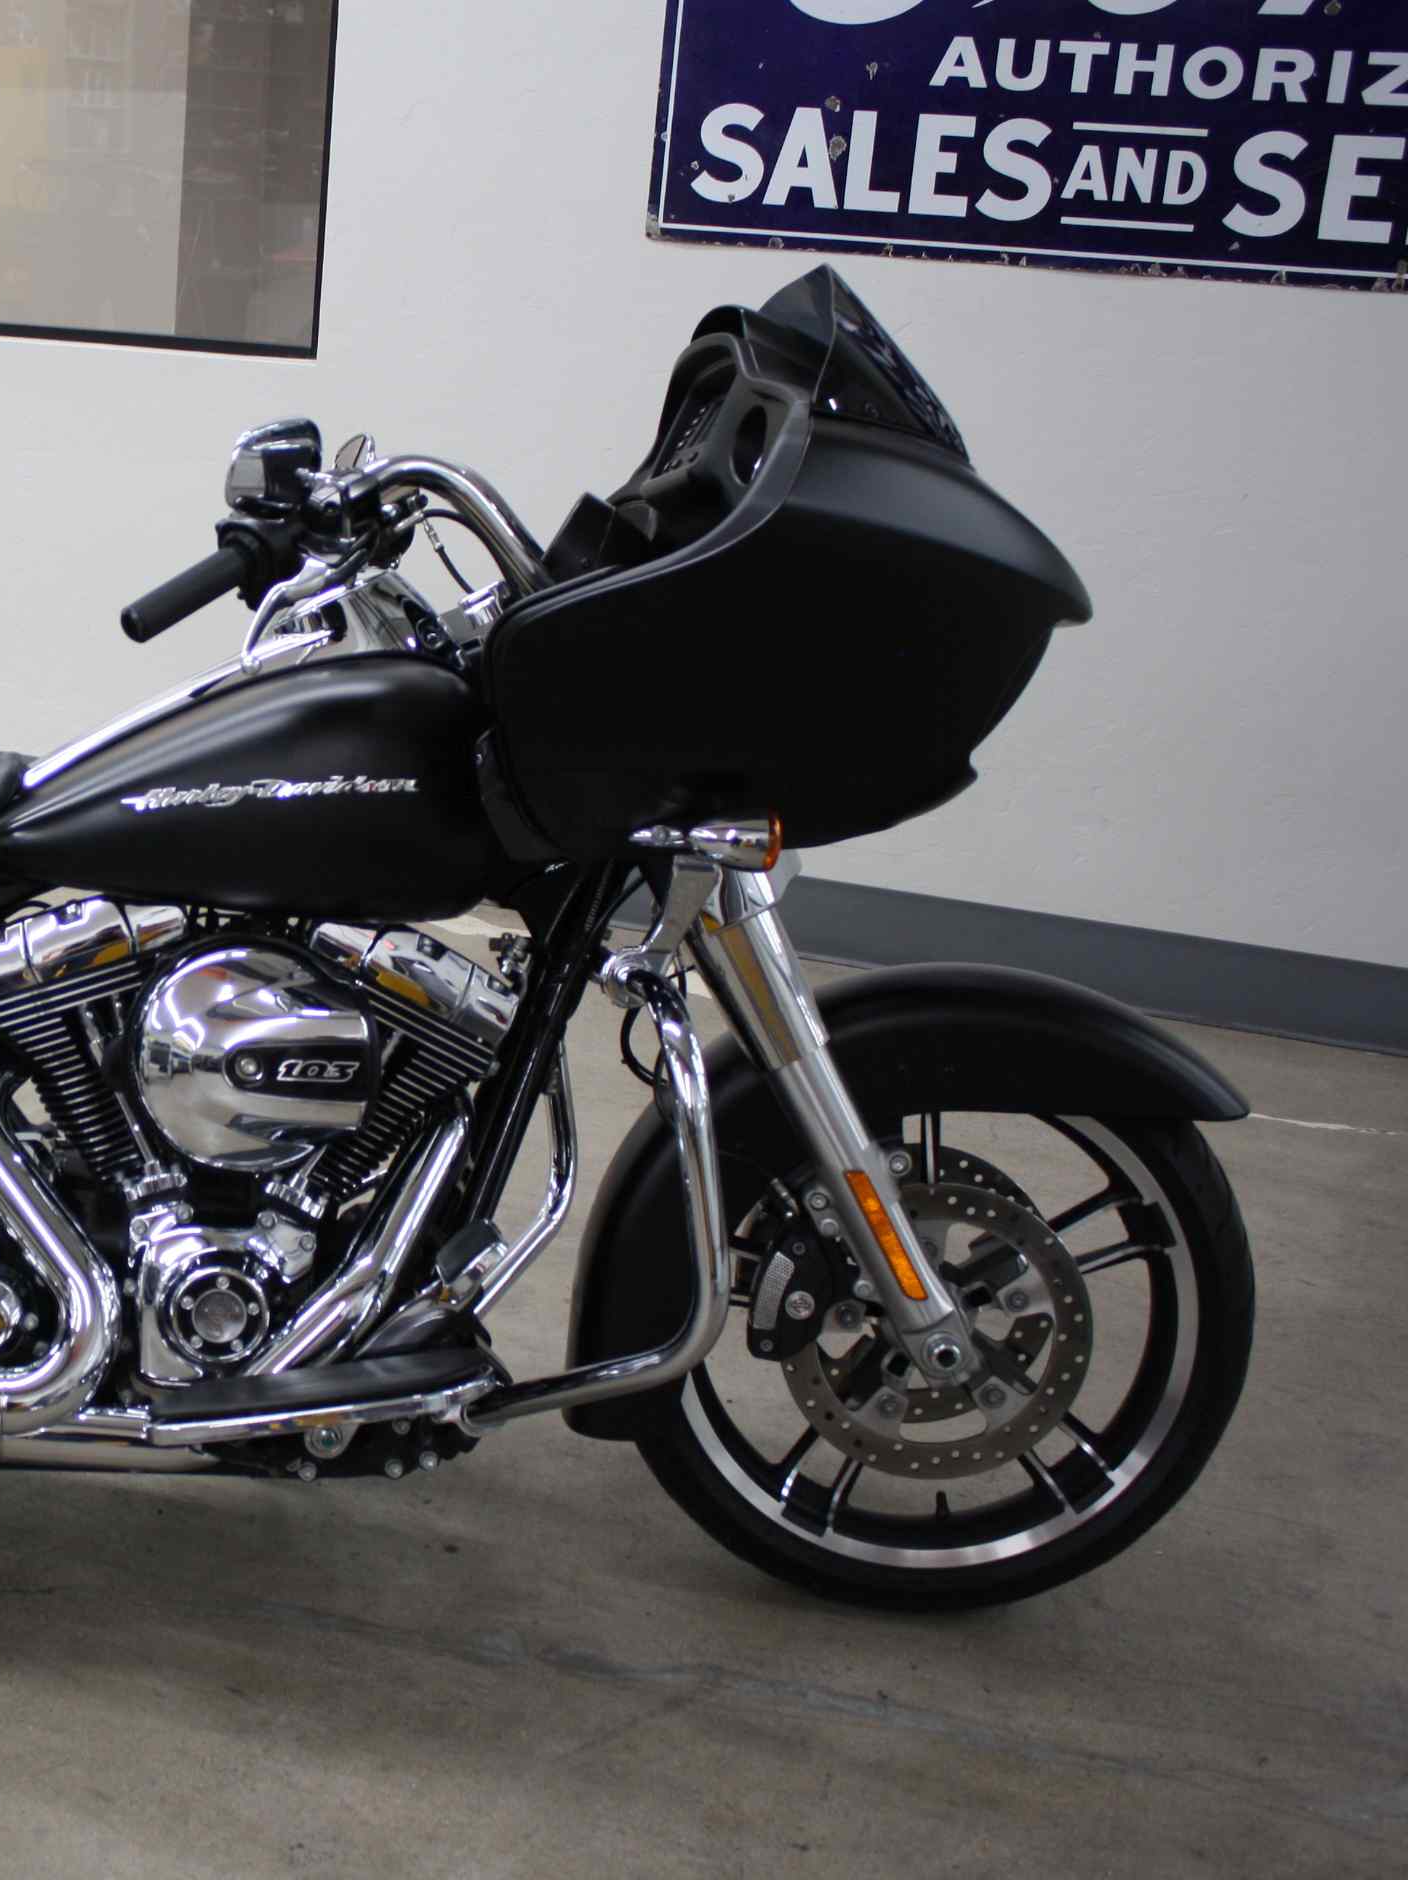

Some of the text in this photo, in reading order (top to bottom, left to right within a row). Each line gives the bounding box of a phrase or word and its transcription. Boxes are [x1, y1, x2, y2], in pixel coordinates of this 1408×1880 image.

[929, 36, 1408, 107] AUTHORIZ
[690, 102, 1053, 222] SALES
[1061, 145, 1208, 206] AND
[276, 1059, 360, 1082] 103
